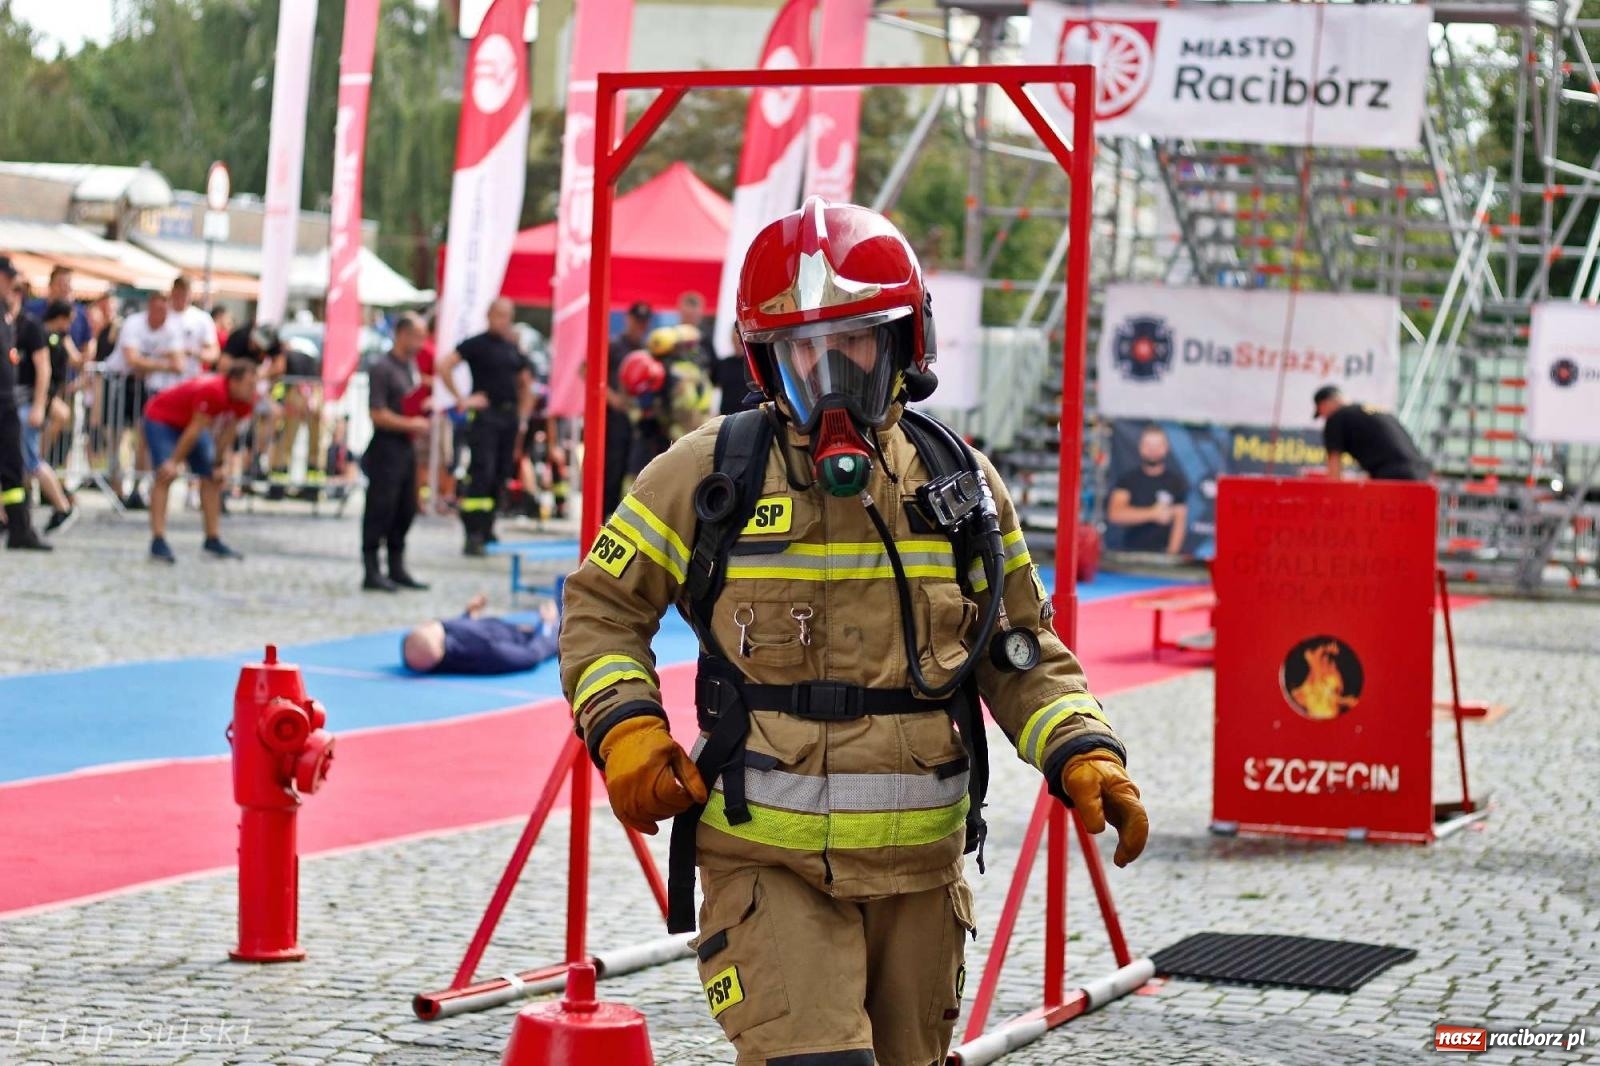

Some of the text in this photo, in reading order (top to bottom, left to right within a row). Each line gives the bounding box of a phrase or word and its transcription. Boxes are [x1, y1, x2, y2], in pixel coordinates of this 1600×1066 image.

[1180, 36, 1296, 60] MIASTO
[1173, 64, 1391, 109] Racibórz
[1183, 338, 1375, 378] DlaStraży.pl
[591, 533, 627, 565] PSP
[707, 975, 732, 1010] PSP
